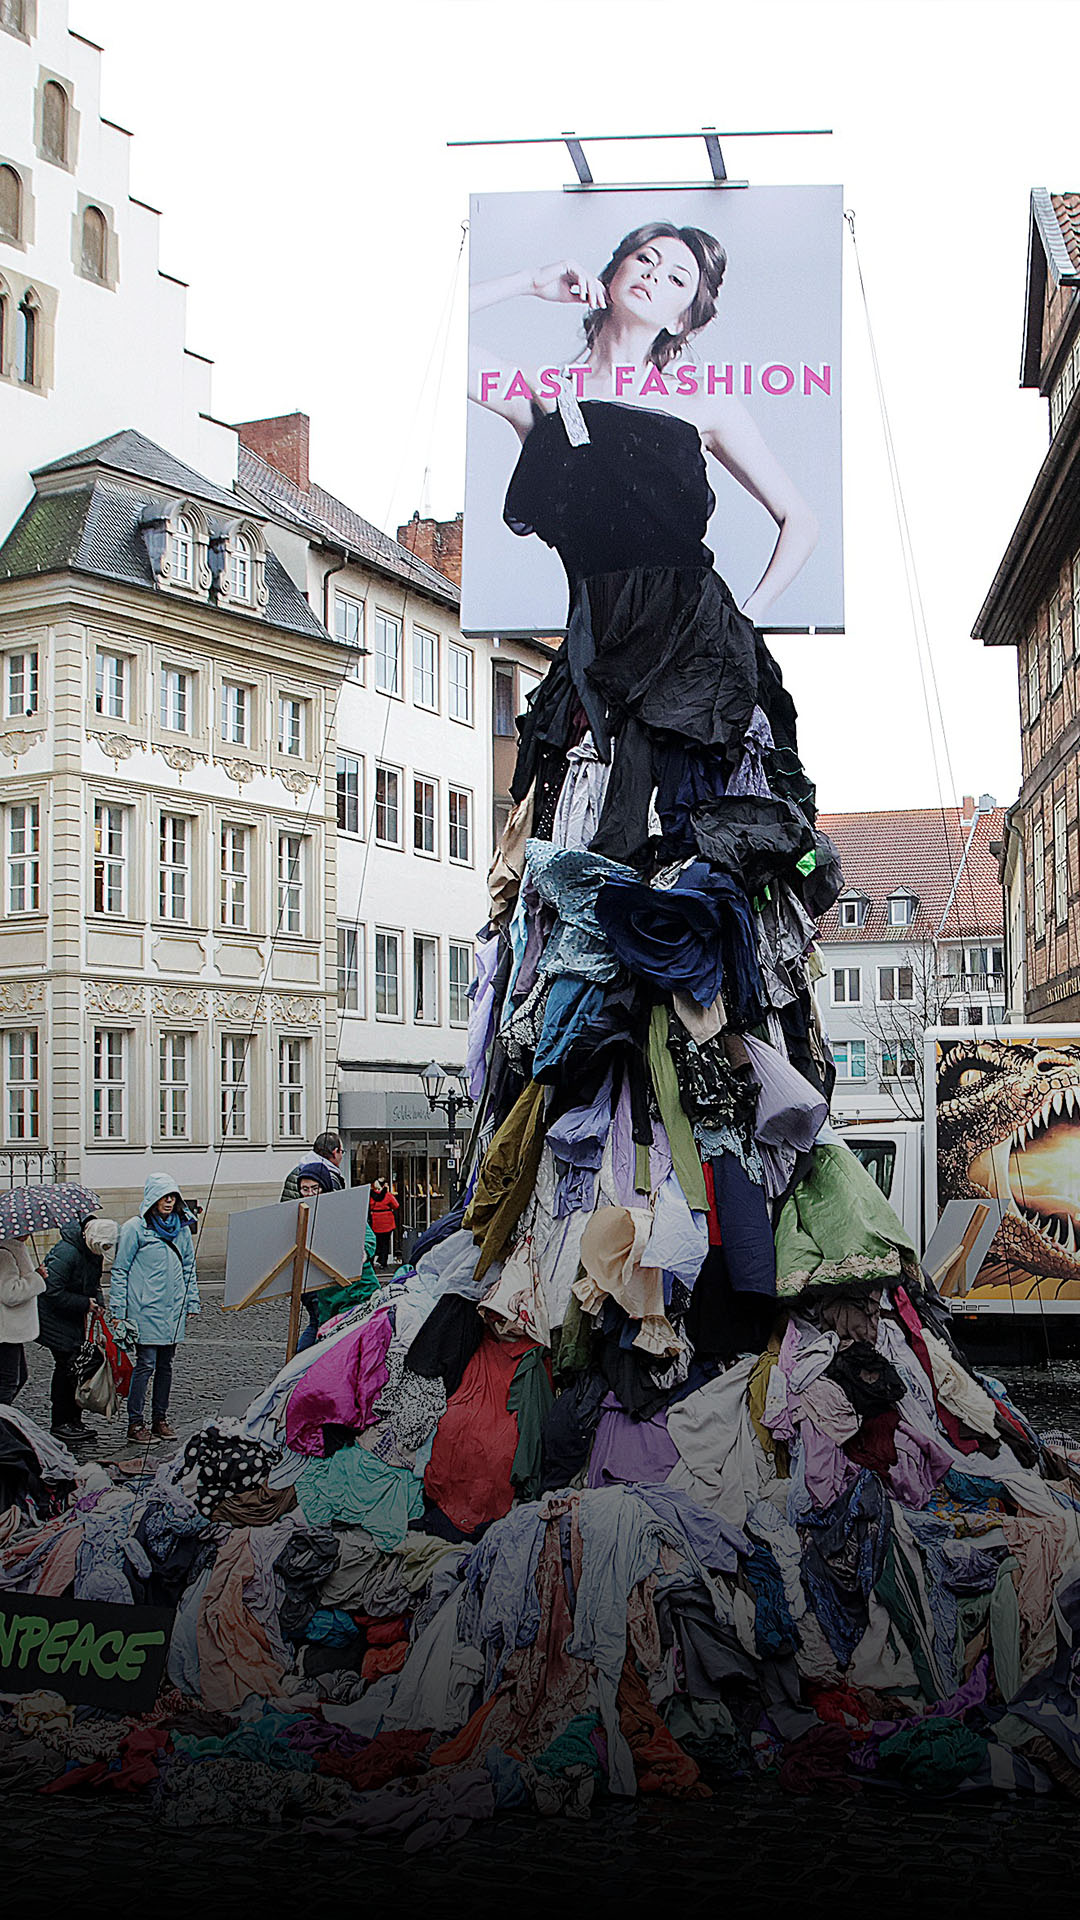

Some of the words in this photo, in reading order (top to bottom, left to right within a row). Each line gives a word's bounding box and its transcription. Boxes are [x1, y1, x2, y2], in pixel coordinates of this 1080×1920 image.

[480, 366, 592, 401] FAST
[614, 364, 832, 396] FASHION
[0, 1611, 165, 1681] NPEACE
